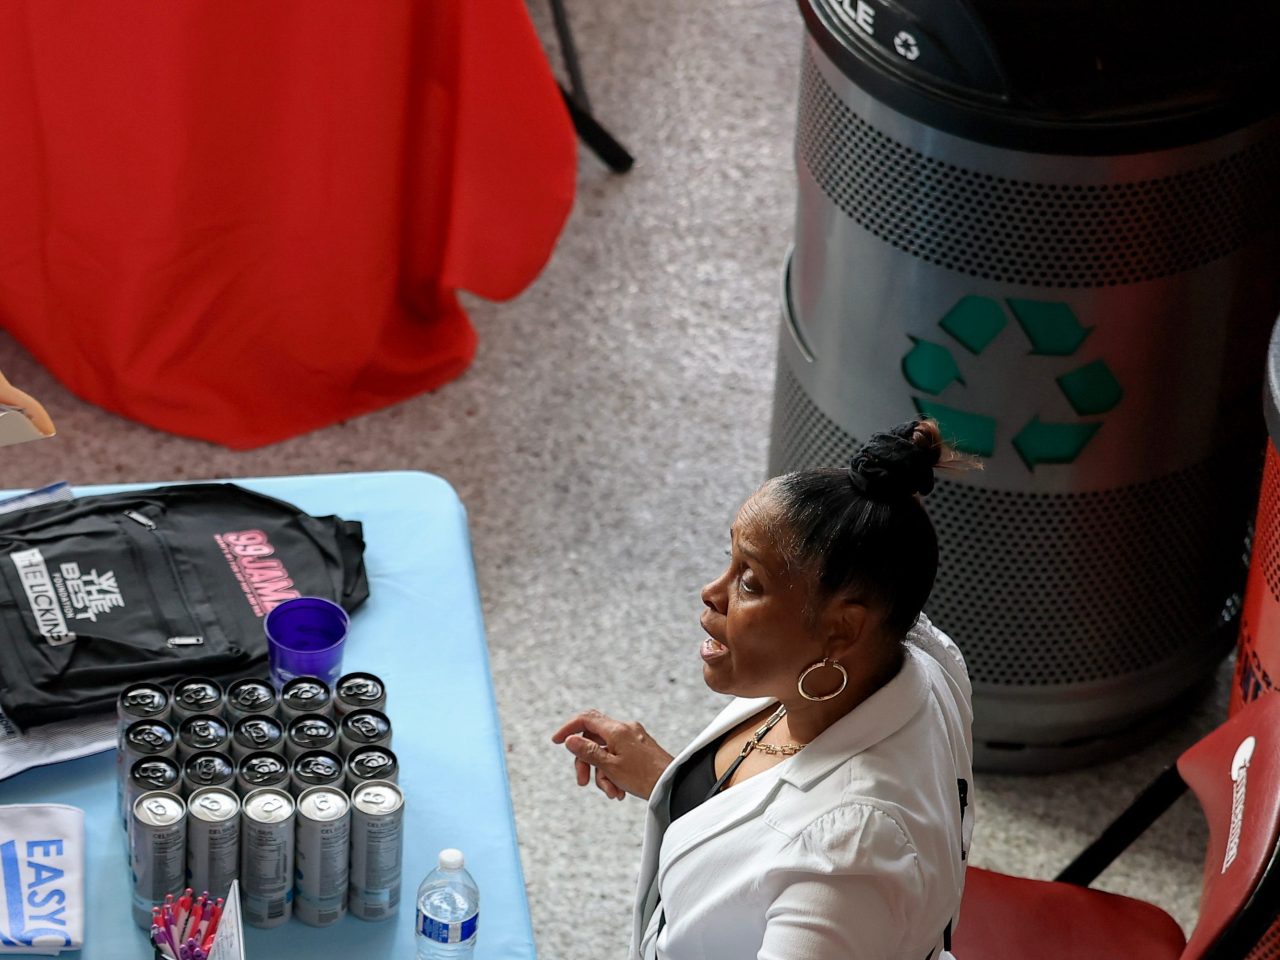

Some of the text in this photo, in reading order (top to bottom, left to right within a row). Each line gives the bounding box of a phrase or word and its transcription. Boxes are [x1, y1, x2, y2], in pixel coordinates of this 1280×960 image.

[52, 572, 76, 619] FOUNDATION
[60, 562, 97, 622] BEST
[80, 568, 112, 614] THE
[98, 570, 125, 607] WE
[222, 530, 302, 613] 99JAM
[26, 839, 66, 926] EASY
